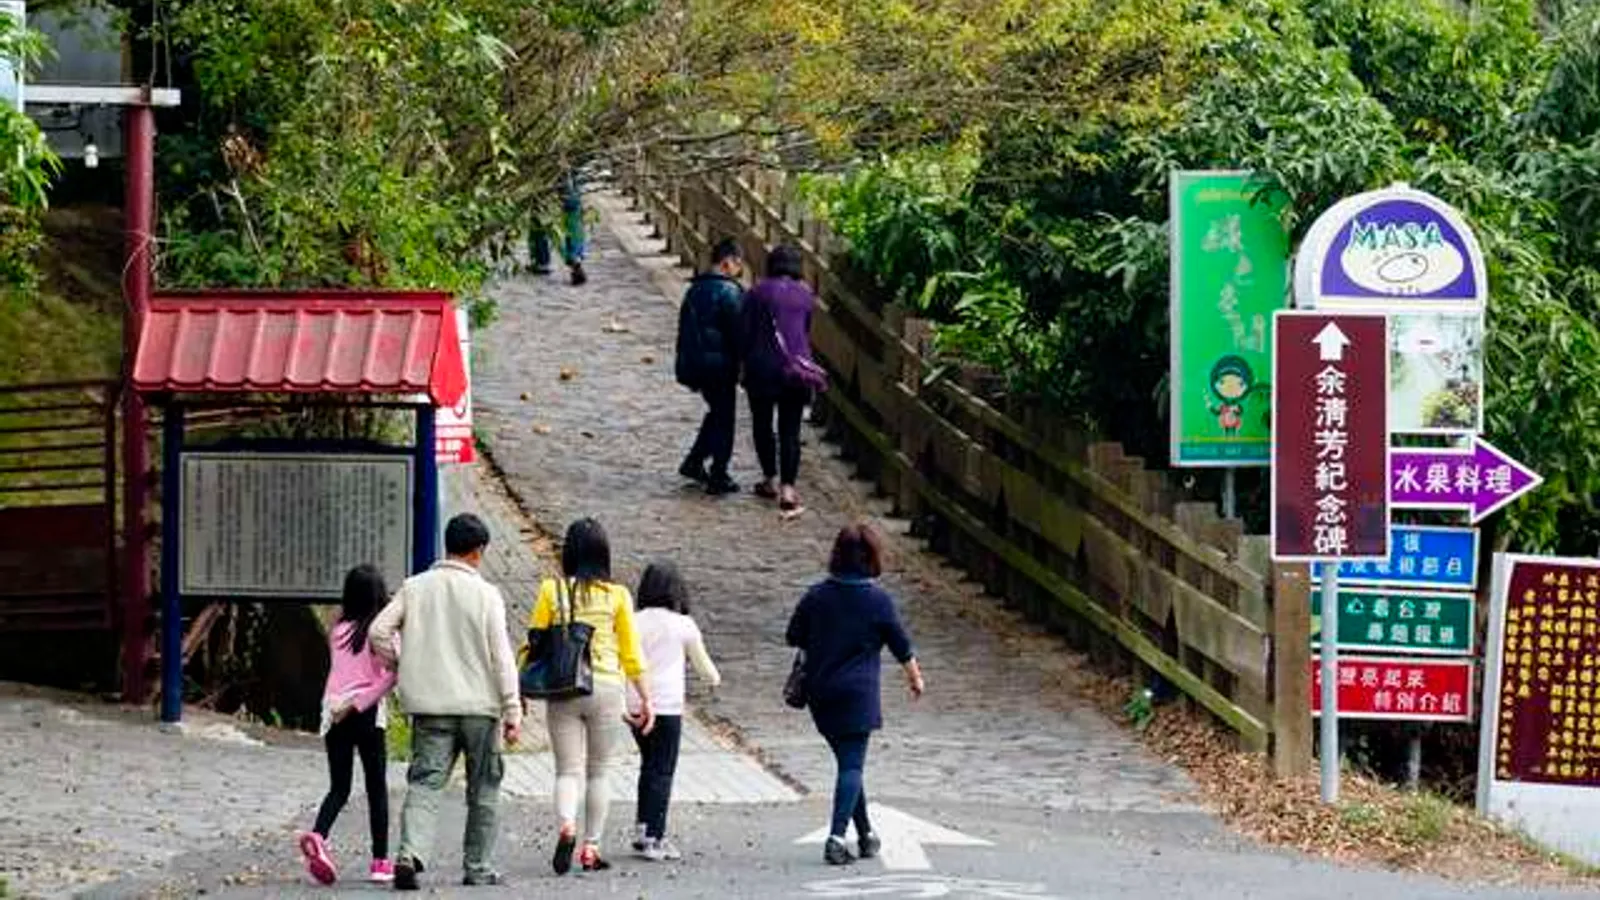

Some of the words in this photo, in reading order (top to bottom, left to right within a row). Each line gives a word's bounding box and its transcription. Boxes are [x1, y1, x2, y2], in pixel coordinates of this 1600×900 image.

[1351, 219, 1443, 250] MASA
[1313, 365, 1349, 556] 余清芳紀念碑
[1394, 462, 1513, 494] 水果料理
